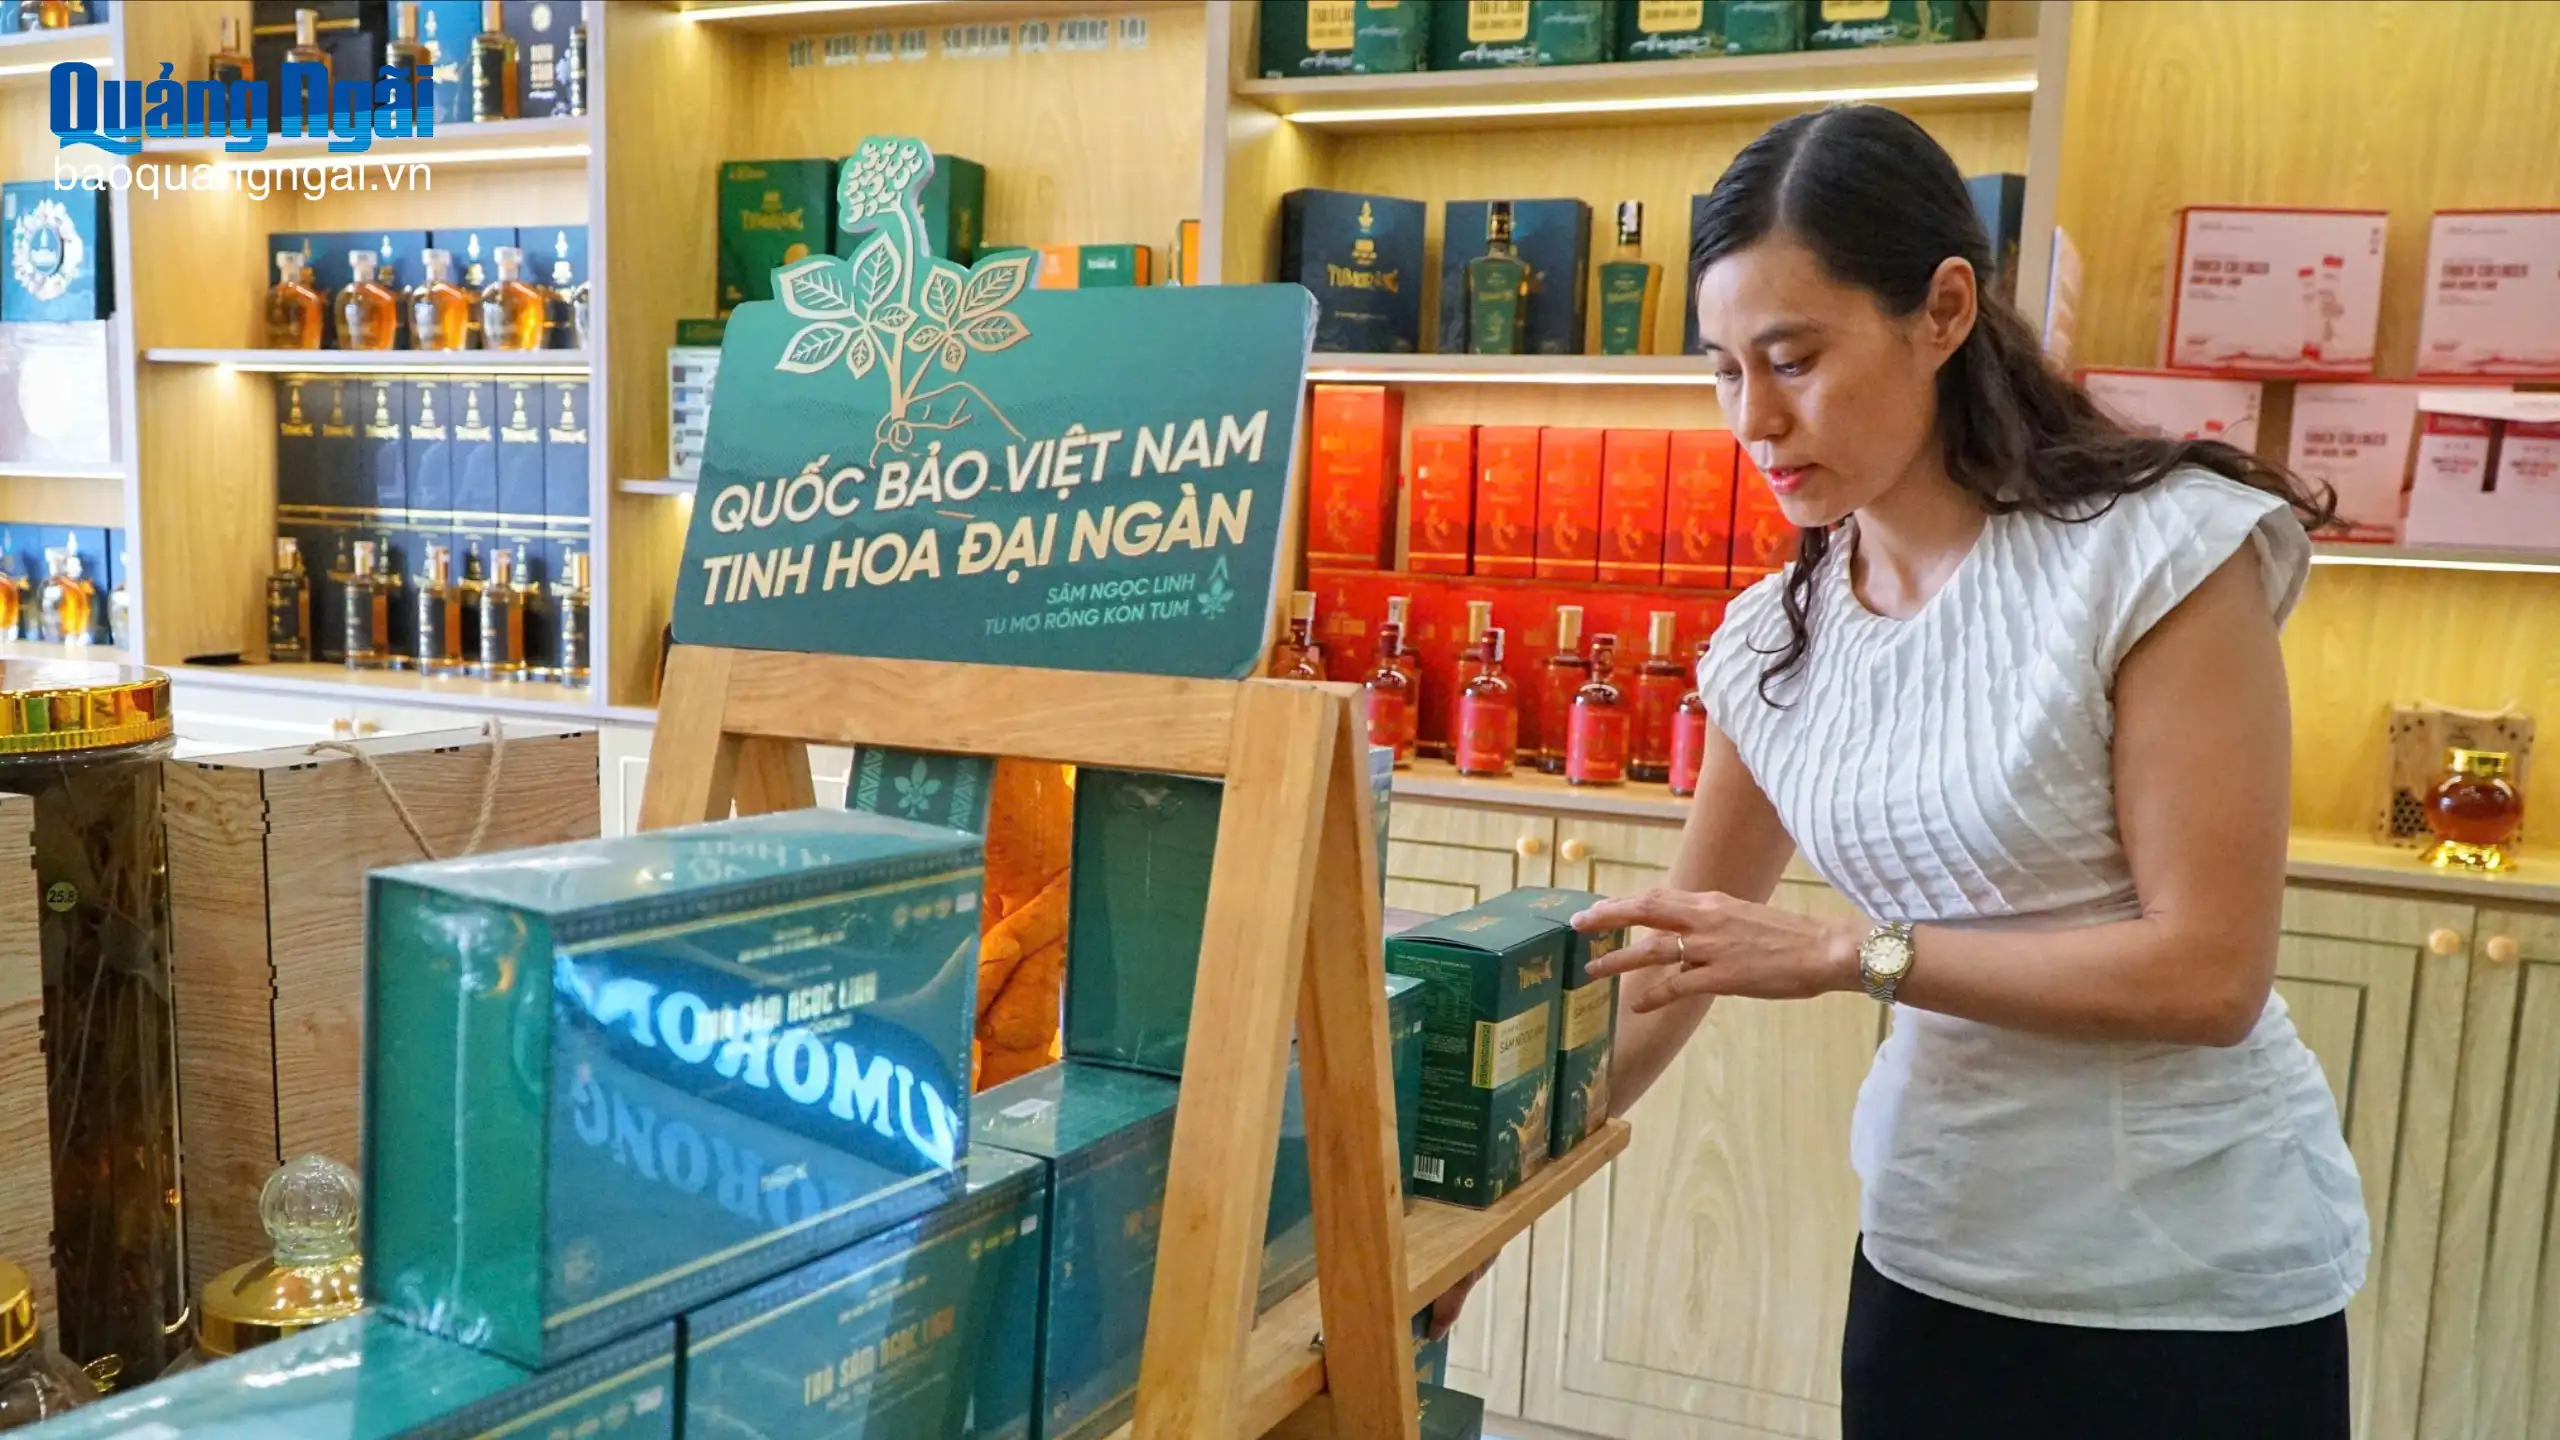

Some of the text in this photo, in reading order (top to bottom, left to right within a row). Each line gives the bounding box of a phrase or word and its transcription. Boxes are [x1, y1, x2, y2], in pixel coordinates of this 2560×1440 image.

[711, 410, 1269, 534] QUỐC BẢO VIỆT NAM
[702, 484, 1254, 606] TINH HOA ĐẠI NGÀN
[984, 598, 1190, 636] TU MƠ RÔNG KON TUM
[1046, 573, 1196, 605] SÂM NGỌC LINH
